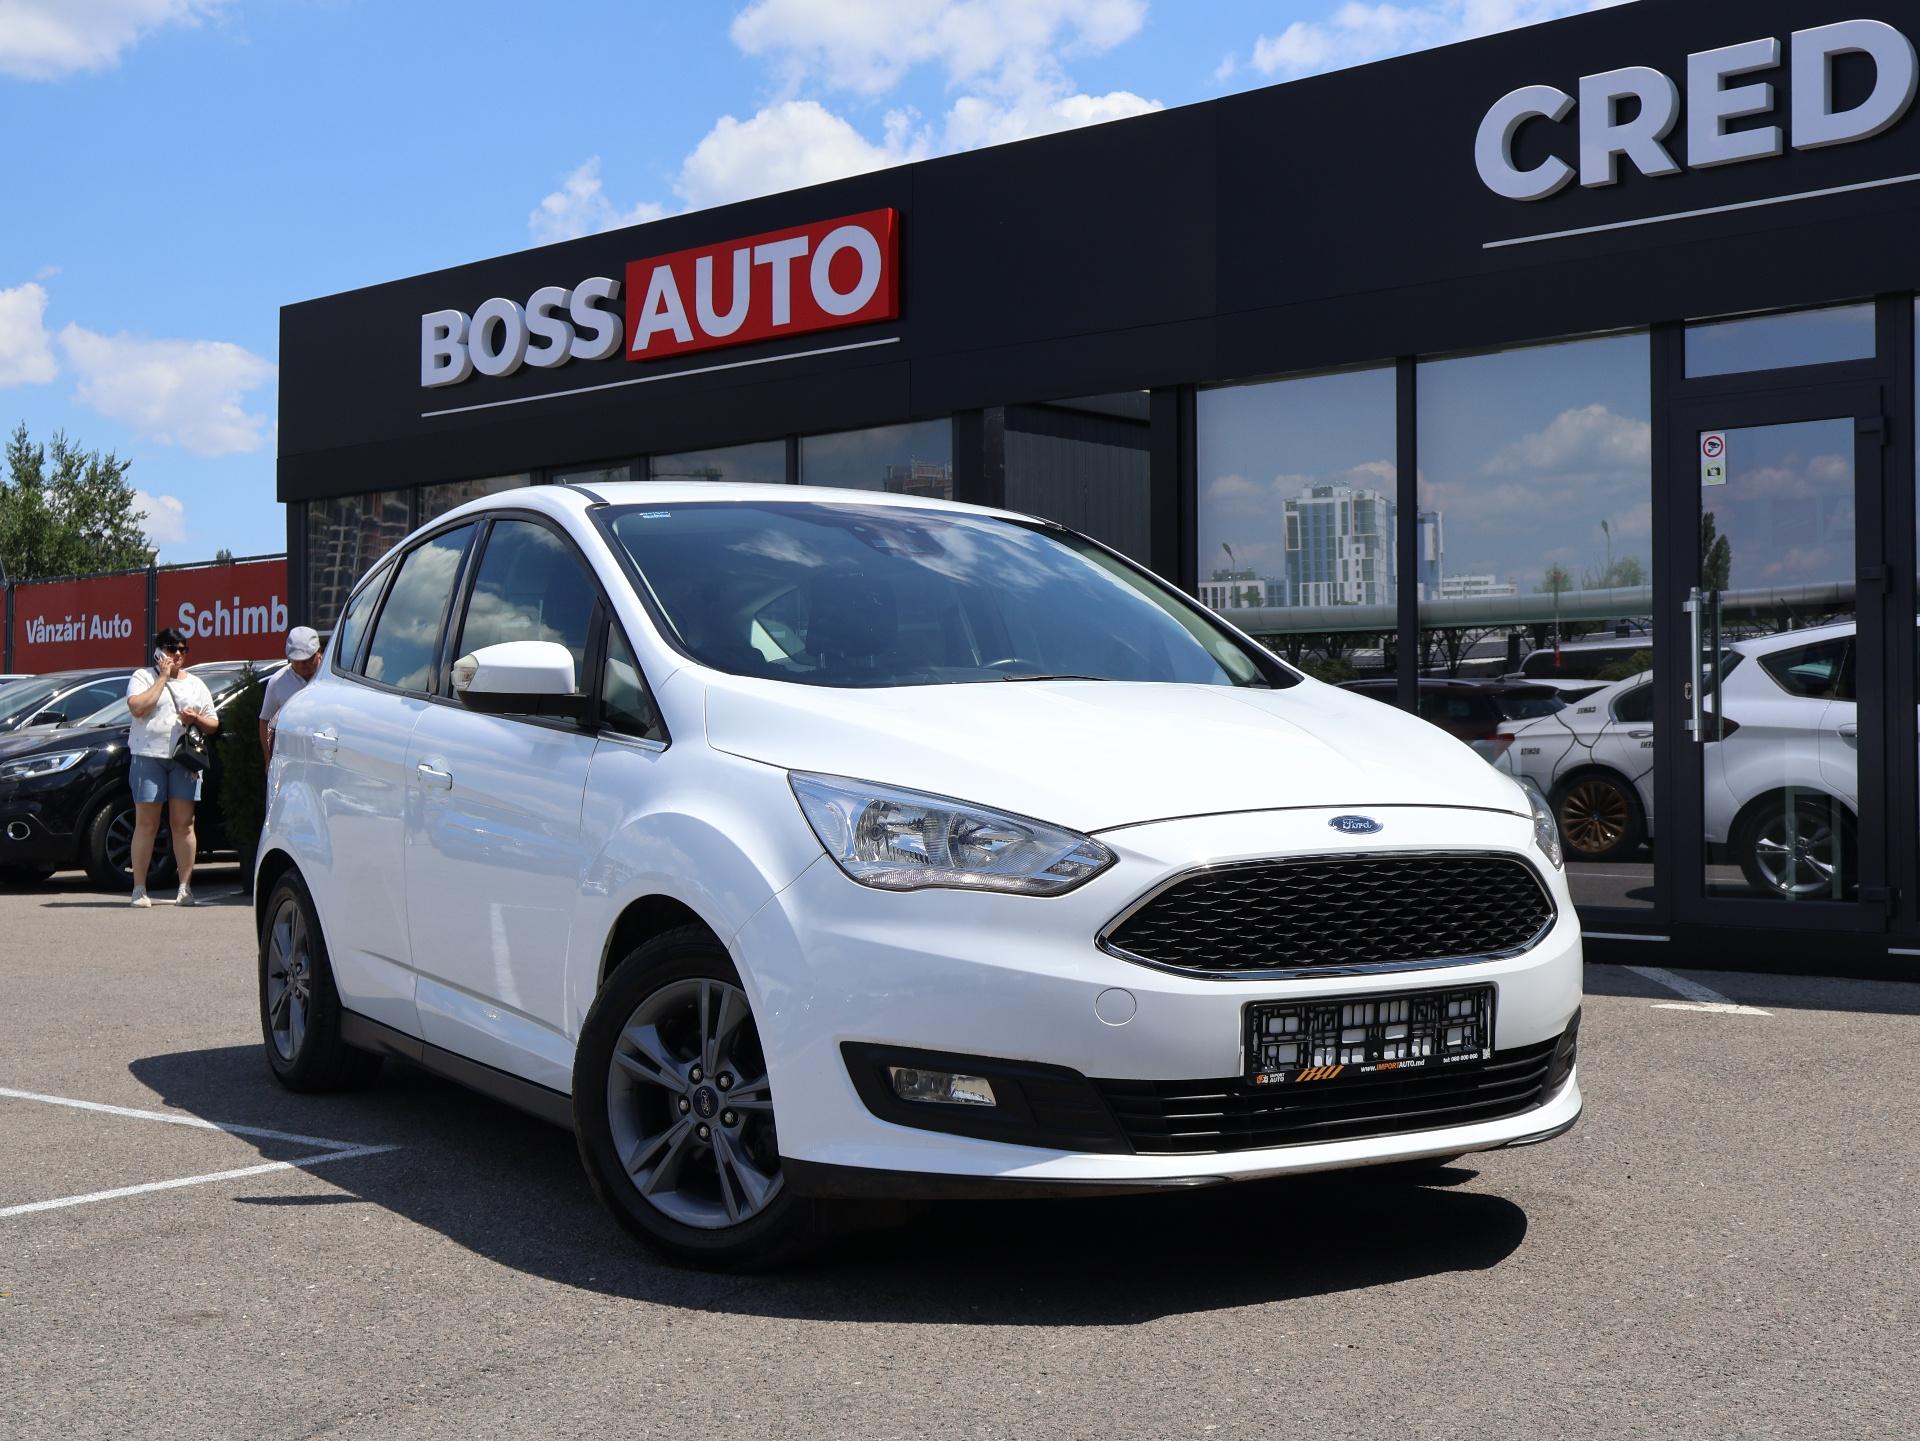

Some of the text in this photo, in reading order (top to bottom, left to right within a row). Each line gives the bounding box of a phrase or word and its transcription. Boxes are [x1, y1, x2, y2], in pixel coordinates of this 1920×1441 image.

[1474, 19, 1919, 202] CRED
[421, 225, 883, 389] BOSS AUTO
[26, 613, 132, 644] Vânzări Auto
[178, 596, 288, 639] Schimb
[1342, 818, 1372, 830] Ford
[1360, 1059, 1425, 1073] www.IMPORTAUTO.md
